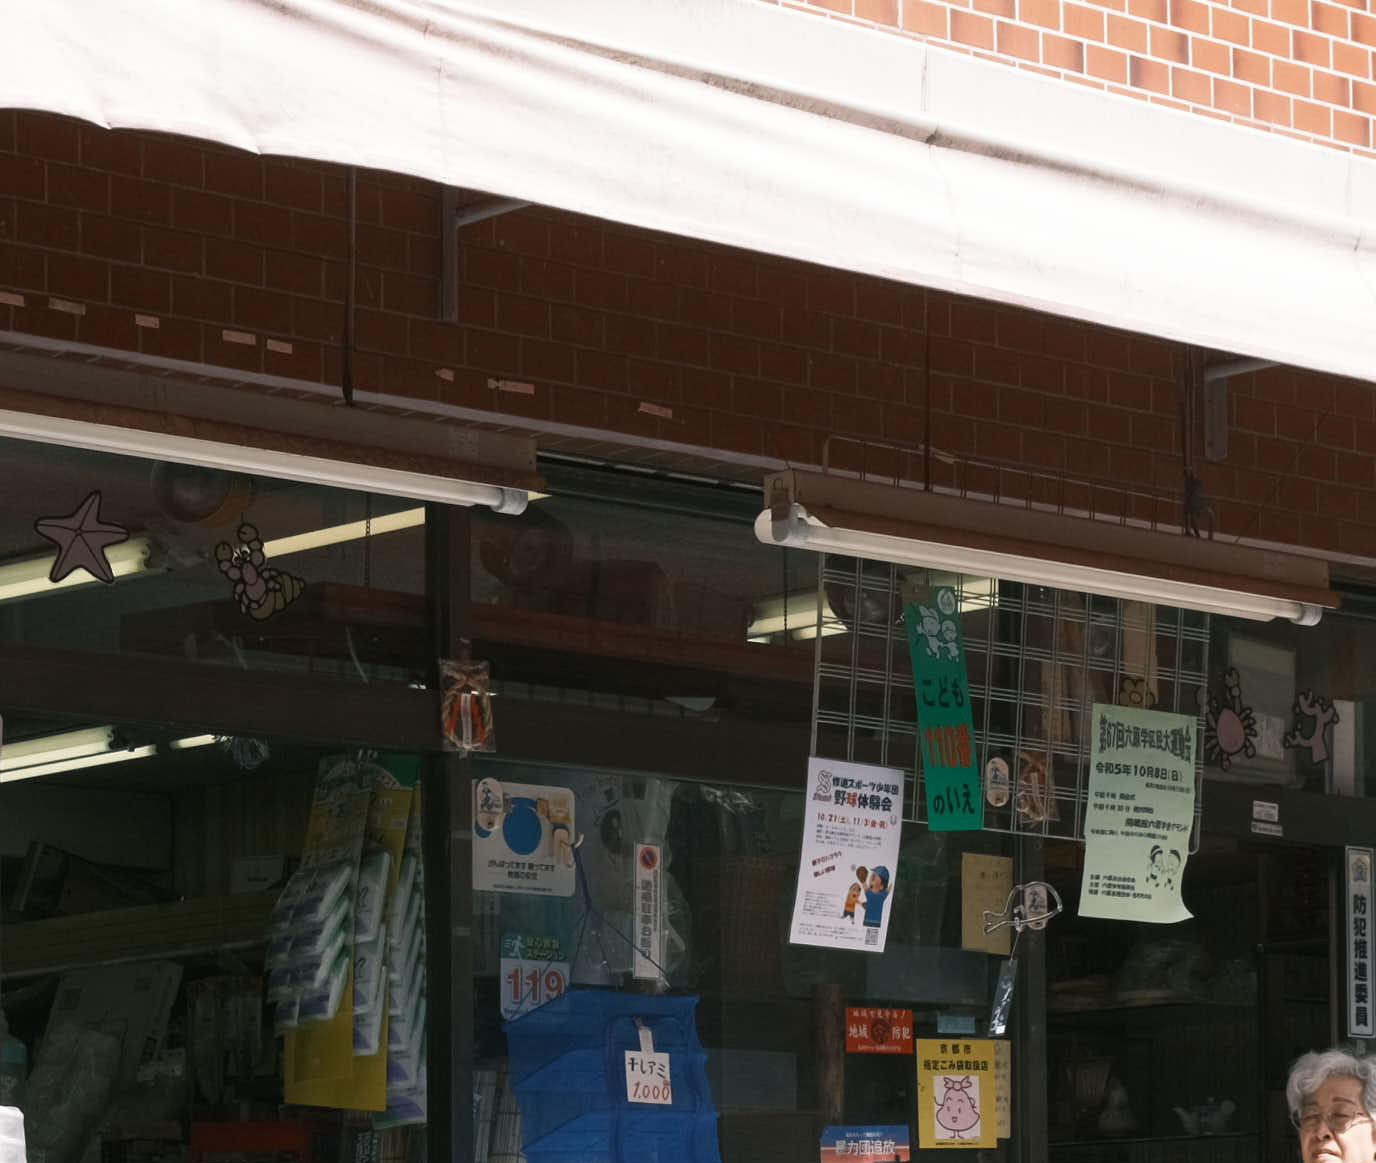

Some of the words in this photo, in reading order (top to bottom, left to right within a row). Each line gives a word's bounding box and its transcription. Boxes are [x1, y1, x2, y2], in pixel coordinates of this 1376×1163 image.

[921, 675, 965, 707] こども
[925, 723, 973, 769] 110番
[834, 790, 893, 812] 野球体験会
[933, 784, 975, 816] のいえ
[1353, 893, 1369, 1027] 防犯推進委員
[506, 967, 564, 1001] 119
[849, 1025, 869, 1039] 地域
[891, 1026, 911, 1040] 防犯
[940, 1044, 972, 1055] 京都市
[835, 1139, 896, 1156] 暴力団追放
